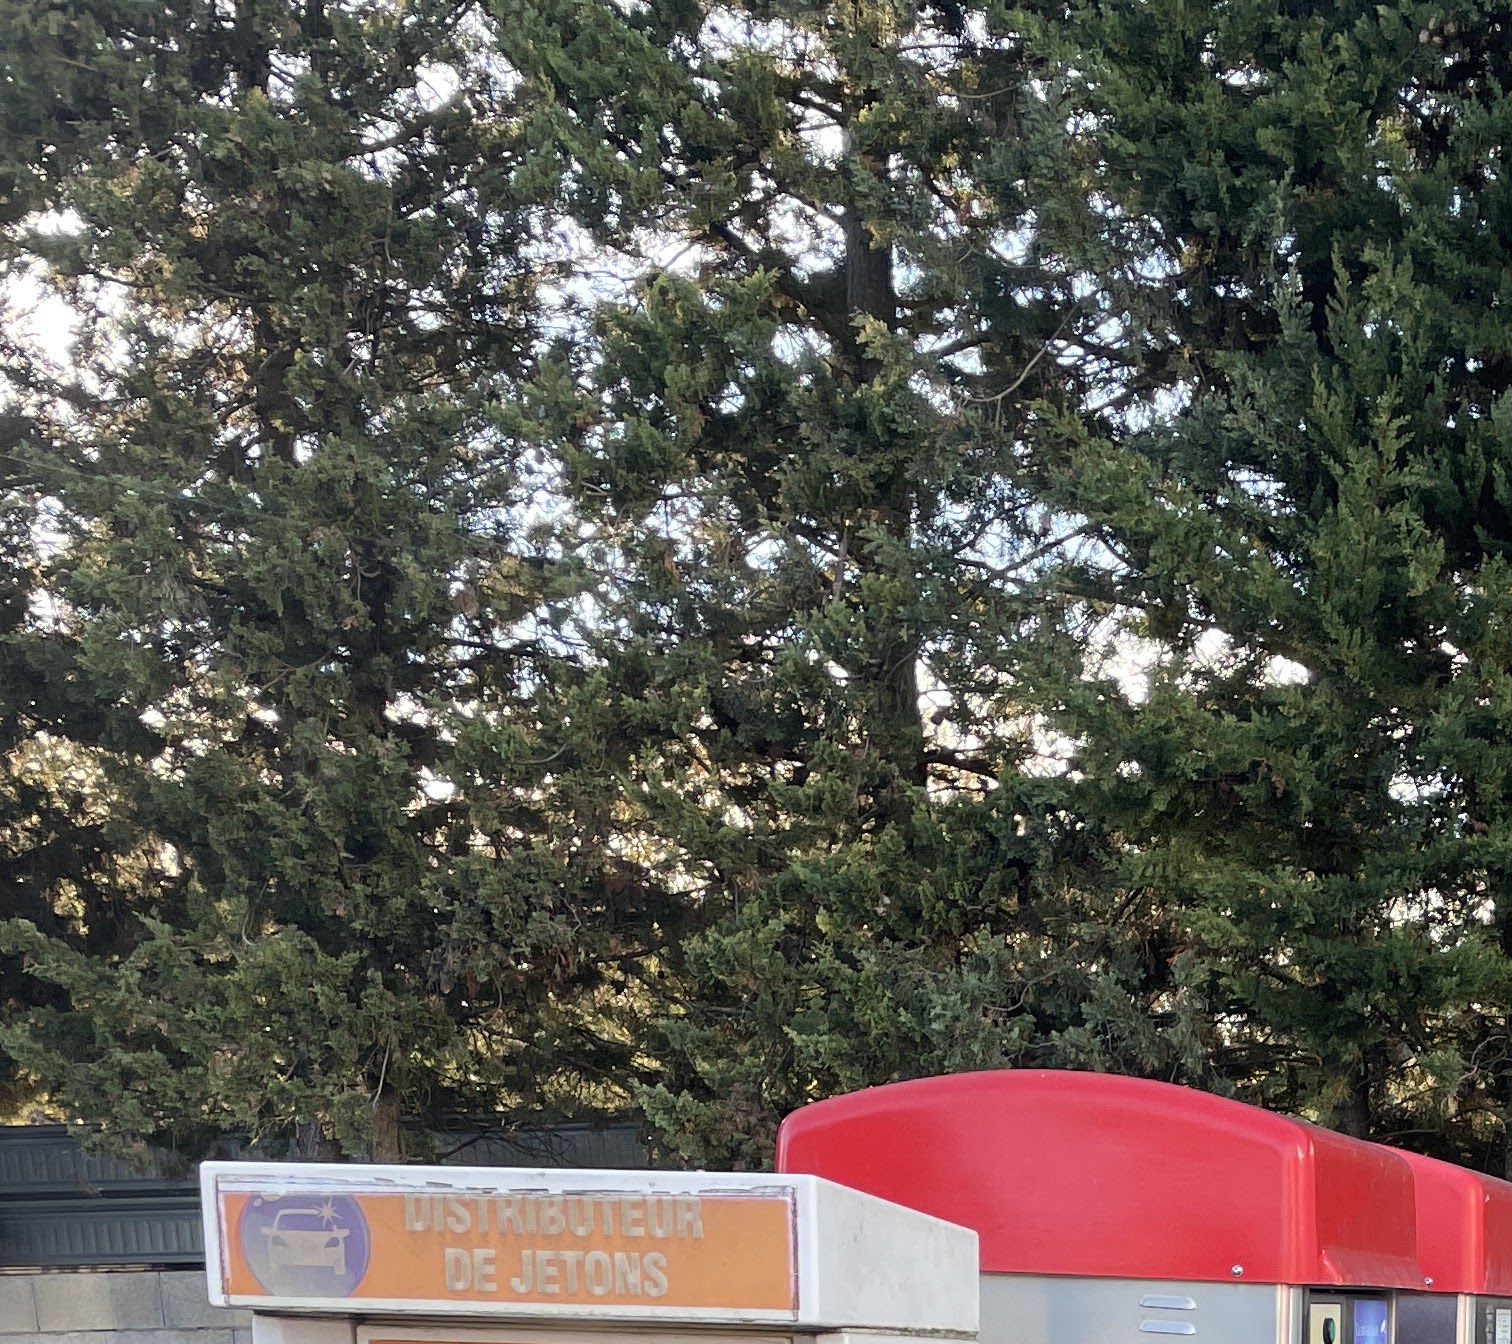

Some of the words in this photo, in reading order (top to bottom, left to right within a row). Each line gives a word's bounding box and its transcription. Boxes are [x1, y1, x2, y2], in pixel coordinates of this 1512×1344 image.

[405, 1195, 704, 1238] DISTRIBUTEUR
[444, 1247, 497, 1292] DE
[511, 1249, 668, 1297] JETONS
